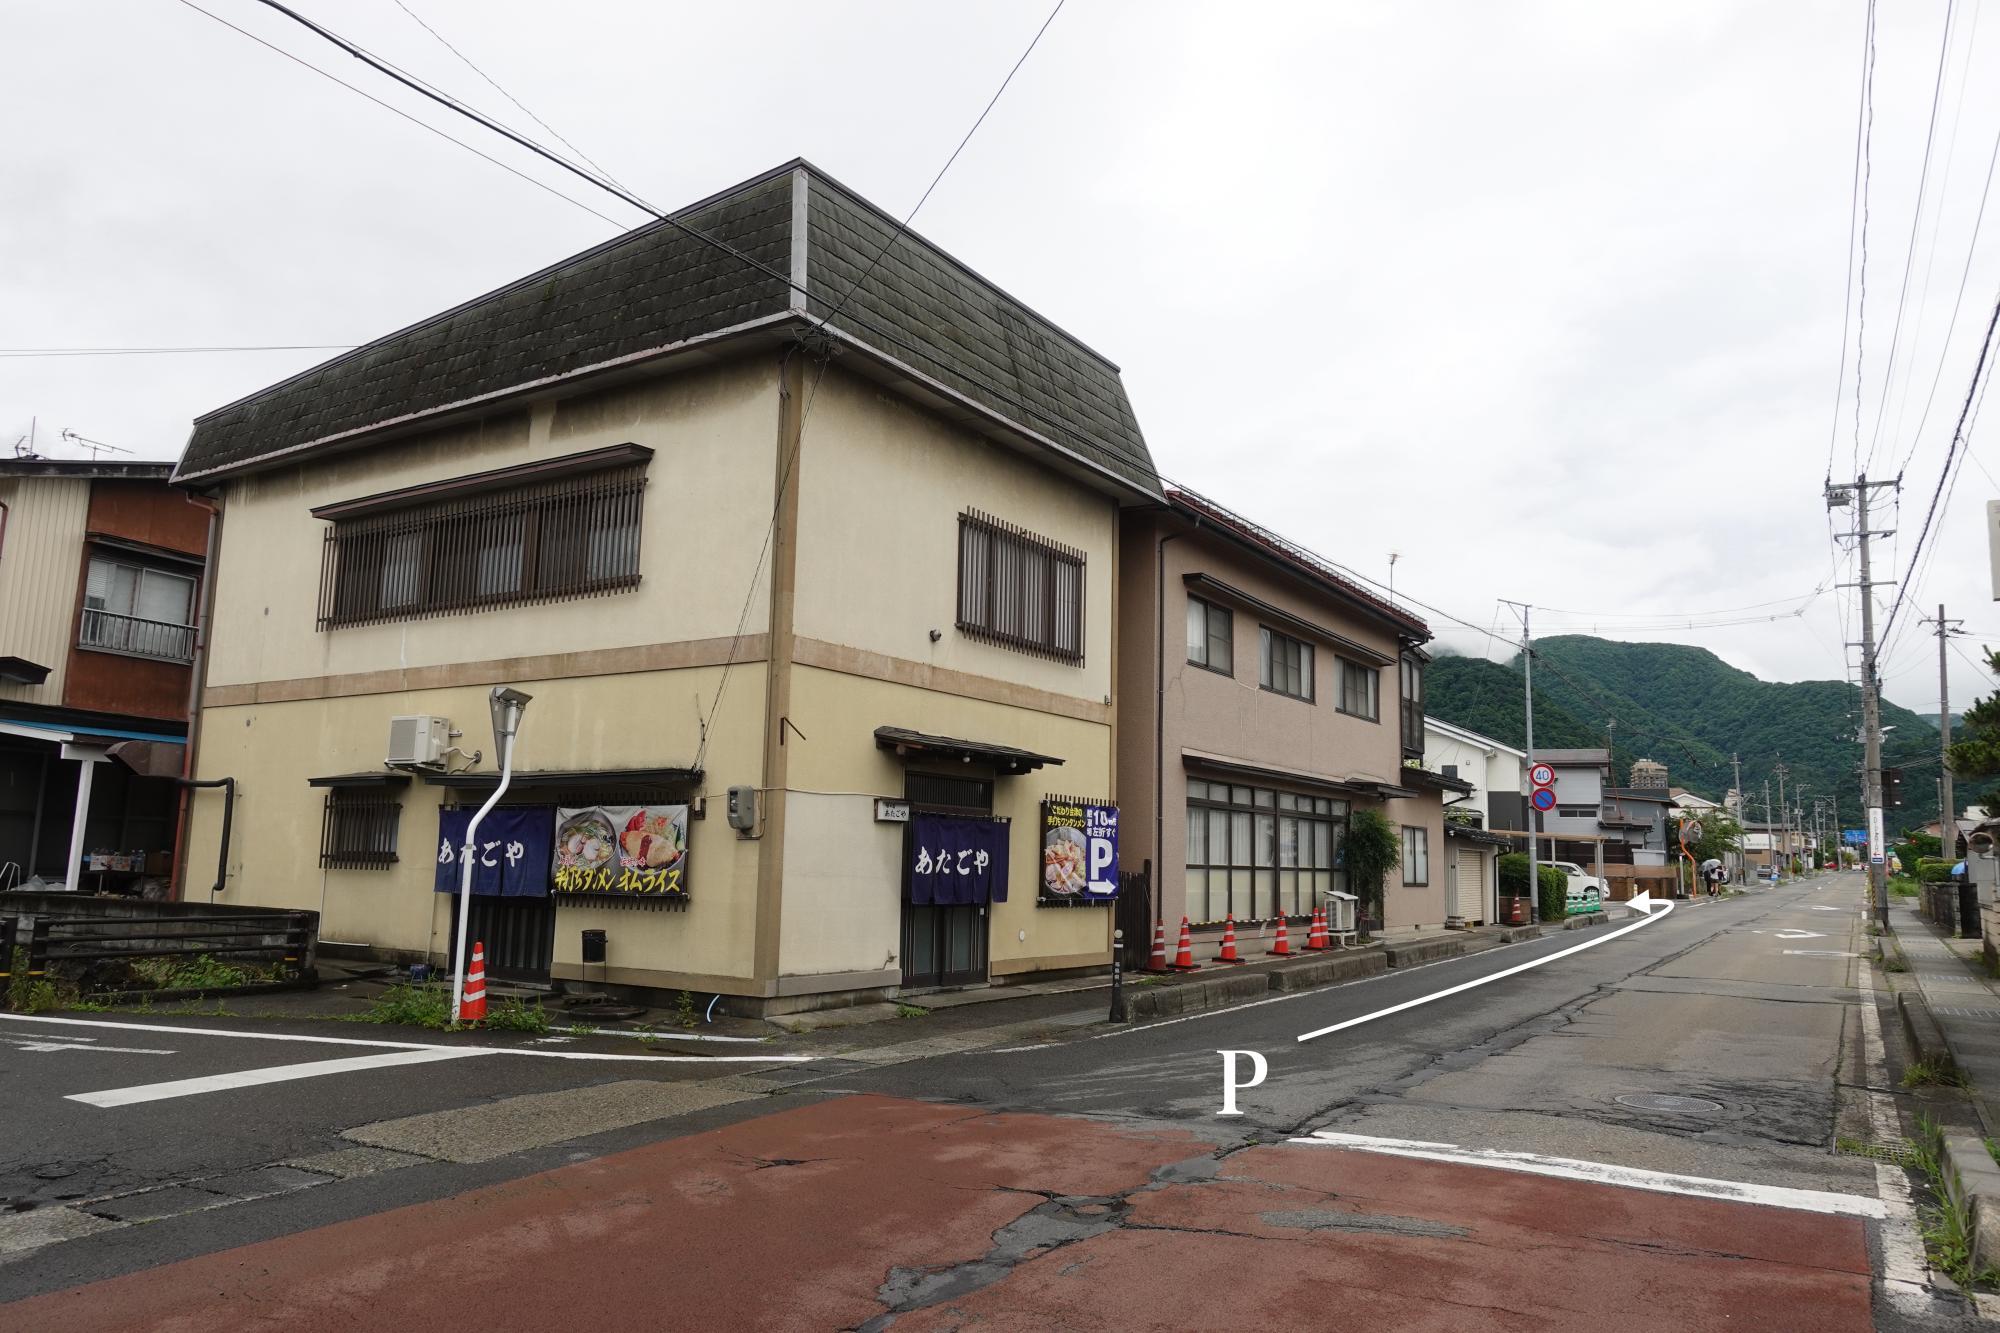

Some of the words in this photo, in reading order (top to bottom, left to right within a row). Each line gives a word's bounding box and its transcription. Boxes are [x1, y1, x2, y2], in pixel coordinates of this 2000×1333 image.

[1536, 769, 1549, 781] 40
[1093, 826, 1116, 838] 左折すぐ
[914, 845, 989, 876] あたごや
[1090, 837, 1113, 881] P
[617, 867, 681, 893] オムライス
